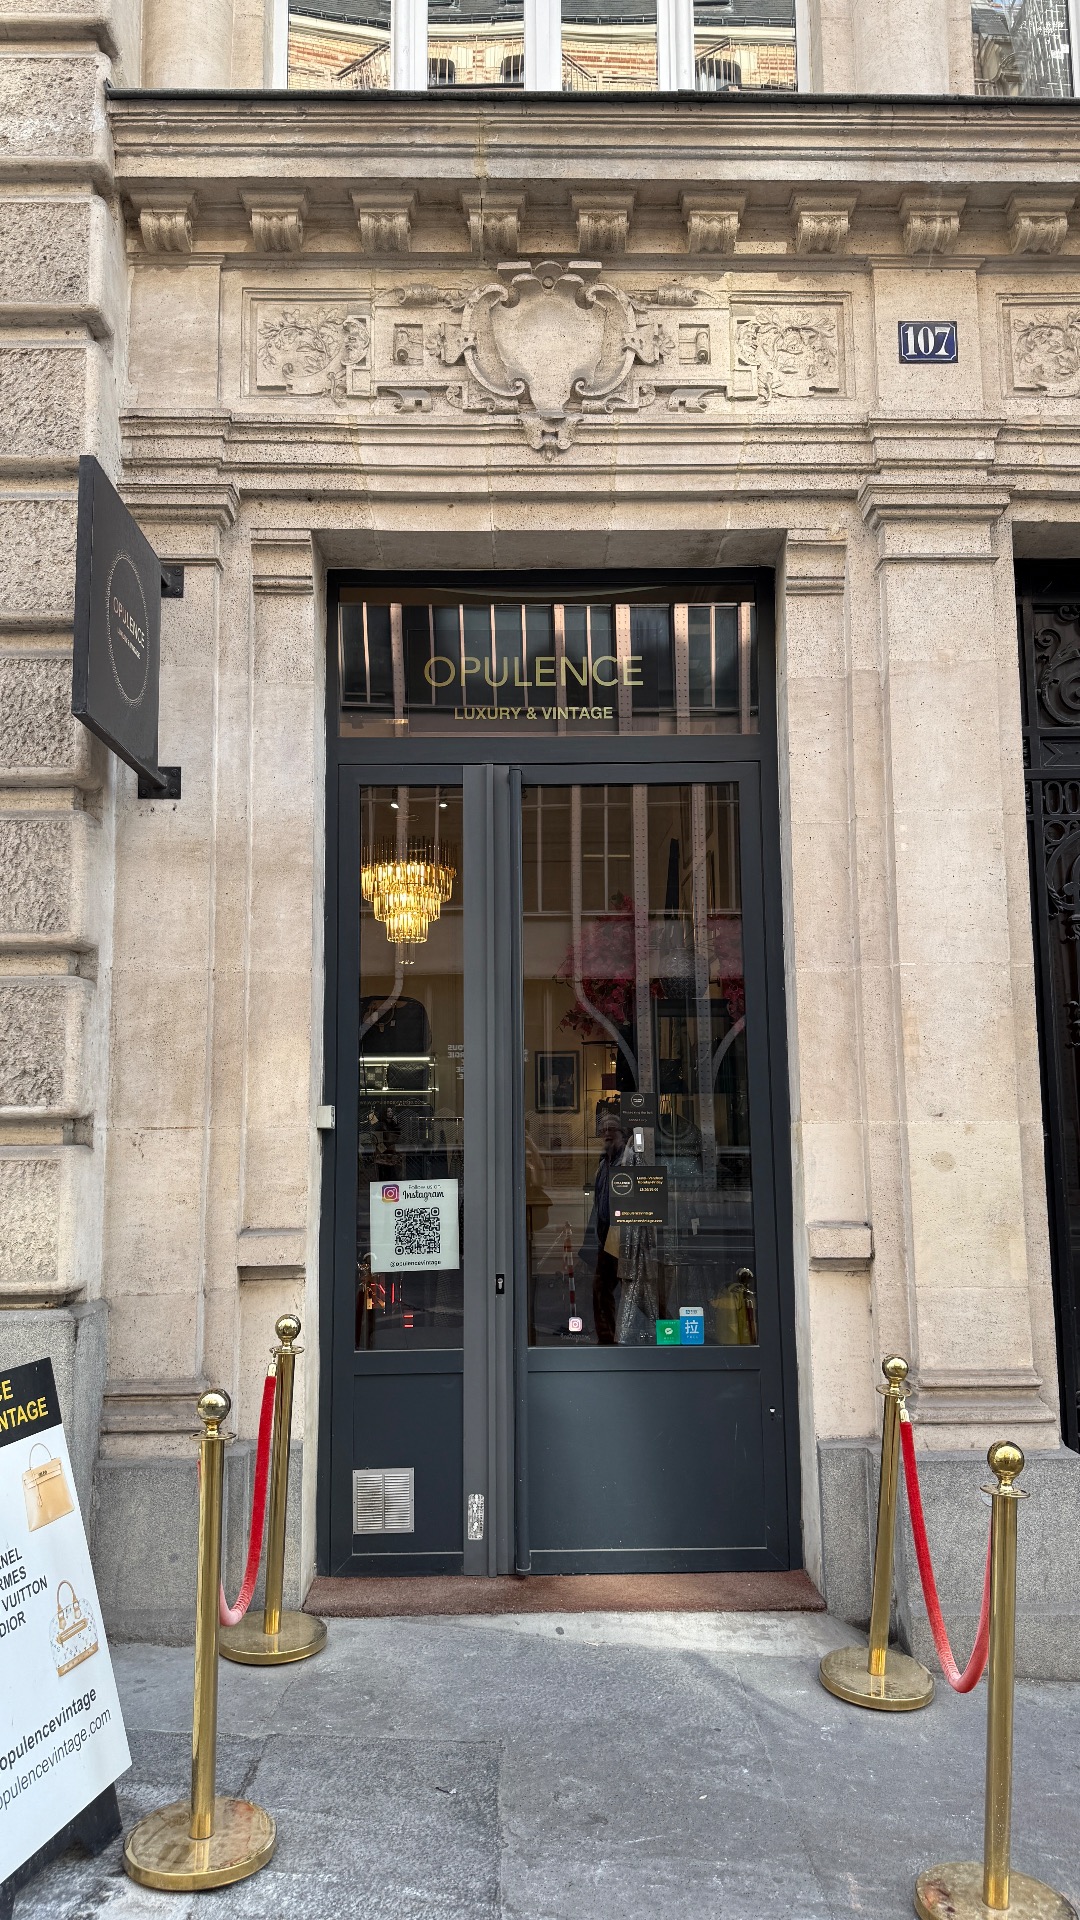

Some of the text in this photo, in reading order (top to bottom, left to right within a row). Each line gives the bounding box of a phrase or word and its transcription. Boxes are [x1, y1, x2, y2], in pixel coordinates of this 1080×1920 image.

[905, 326, 951, 356] 107
[113, 596, 145, 649] OPULENCE
[423, 655, 644, 688] OPULENCE
[454, 706, 613, 720] LUXURY & VINTAGE
[402, 1190, 445, 1203] Instagram
[684, 1319, 700, 1335] 拉
[1, 1575, 48, 1612] VUITTON
[0, 1610, 27, 1638] DIOR
